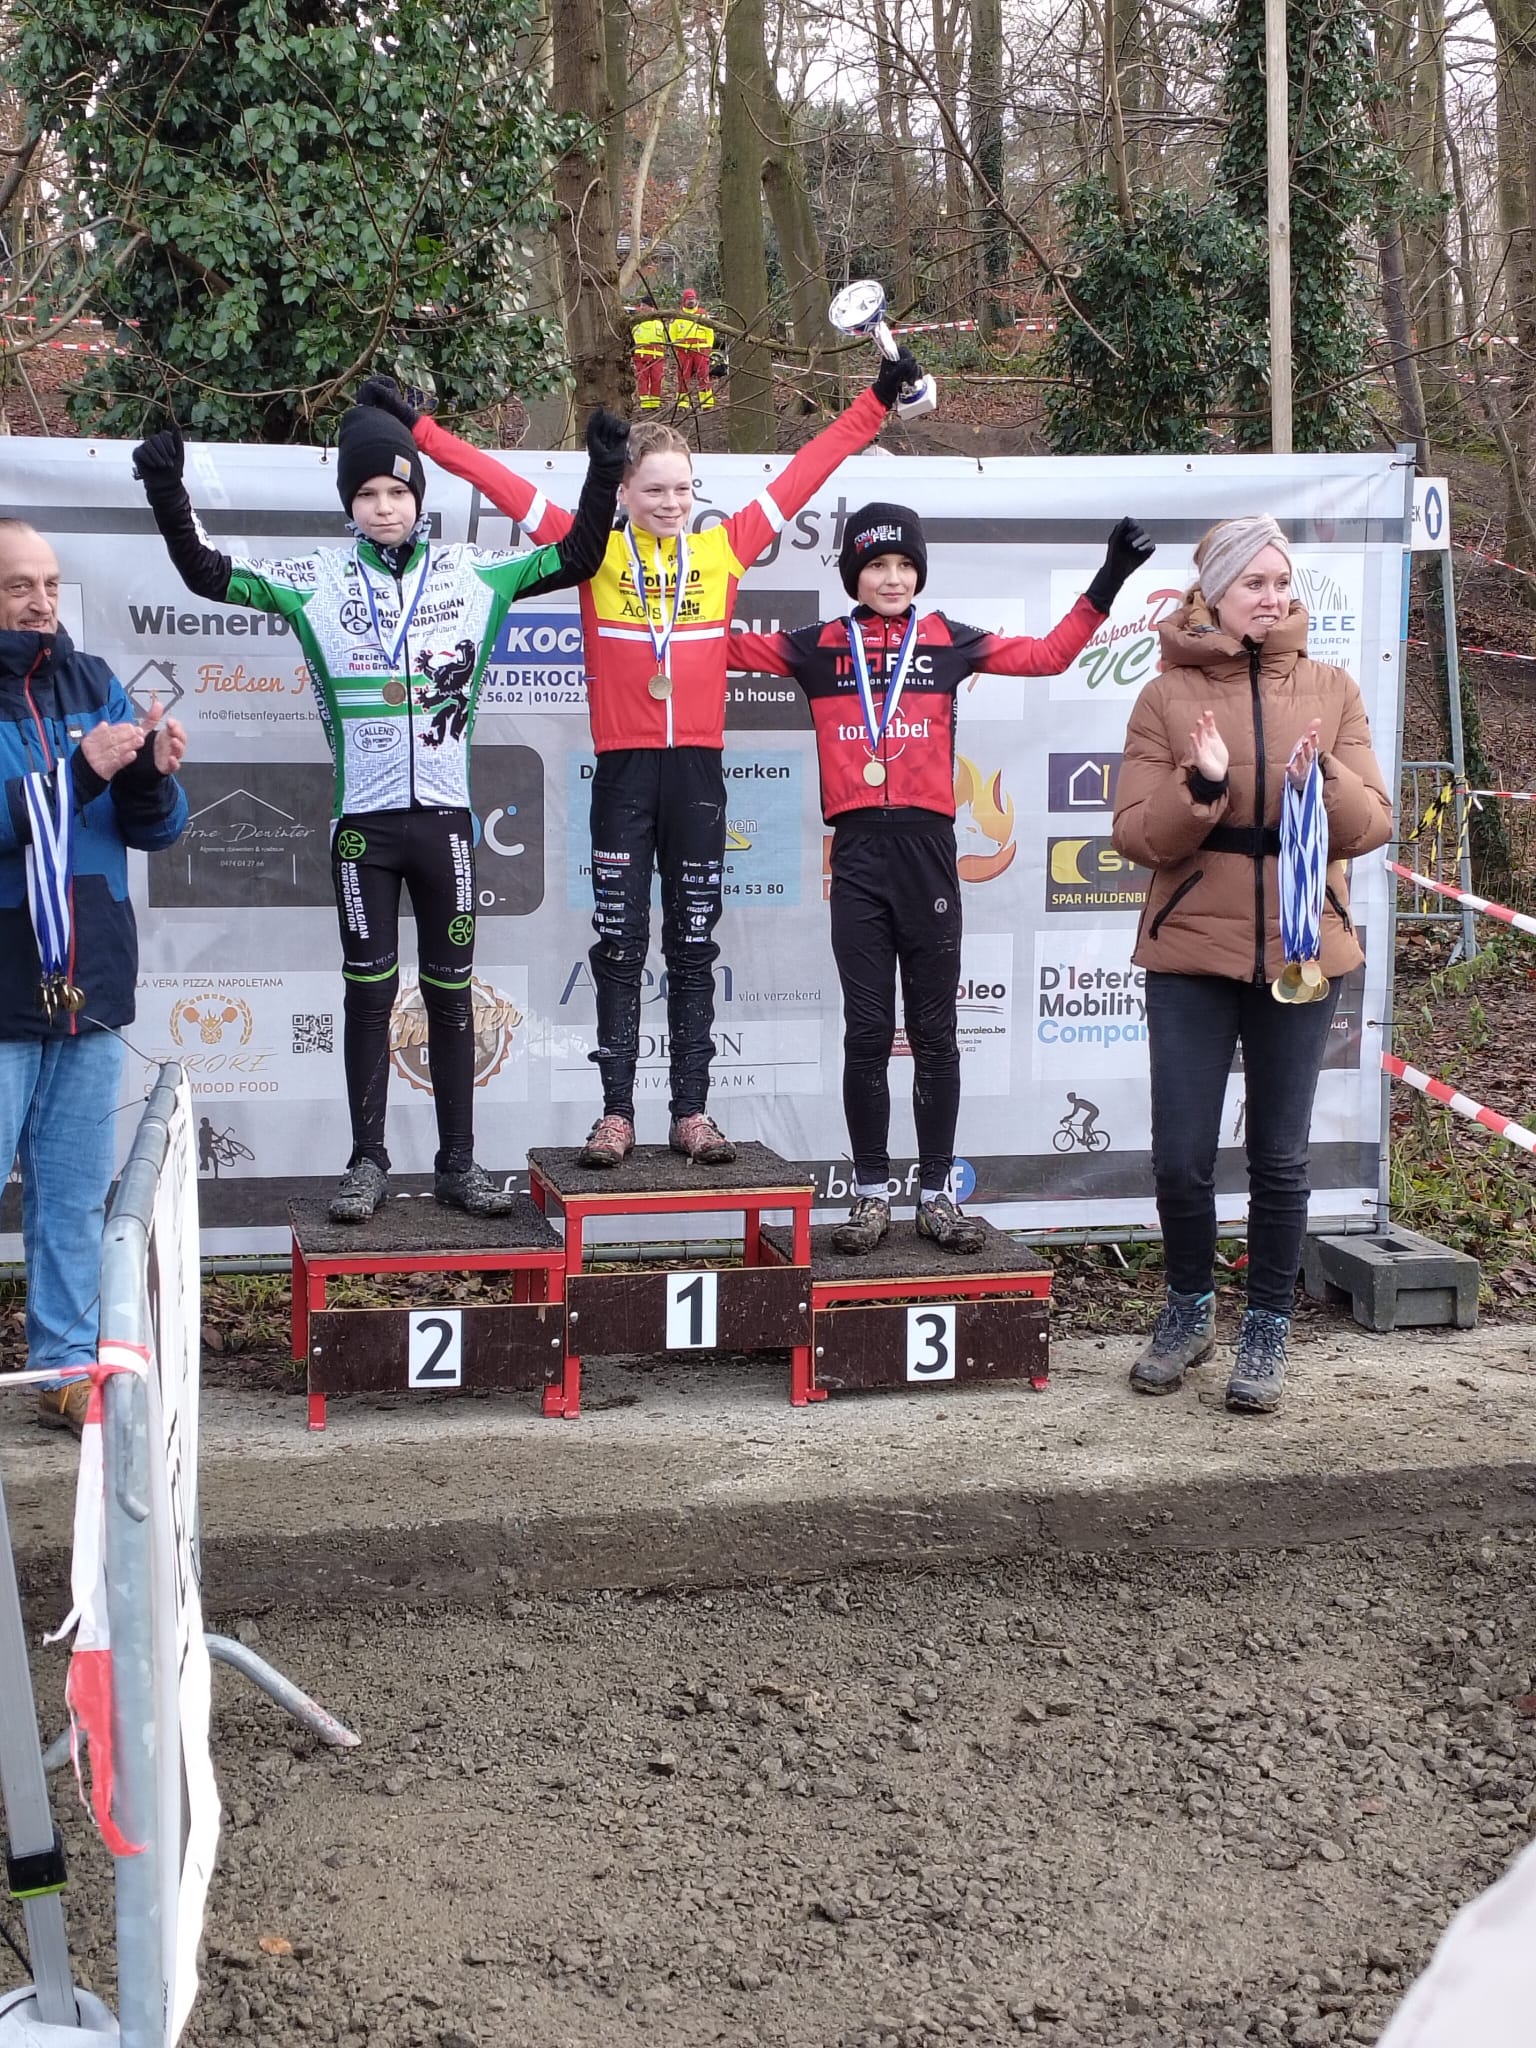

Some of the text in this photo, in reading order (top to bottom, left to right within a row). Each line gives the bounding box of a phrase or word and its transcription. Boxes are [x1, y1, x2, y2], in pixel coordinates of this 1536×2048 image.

[620, 570, 701, 587] LONAD
[420, 597, 465, 616] BELGIAN
[507, 626, 584, 653] KOC
[1309, 637, 1350, 645] EUREN
[195, 663, 286, 695] Fietsen
[748, 688, 796, 702] house
[359, 727, 395, 737] CALLENS
[838, 717, 929, 742] toabel
[449, 832, 464, 877] BELGIAN
[745, 883, 763, 895] 53
[766, 882, 785, 895] 80
[348, 861, 370, 940] ANGLO BELGIAN
[1051, 892, 1147, 905] SPAR HULDENB
[152, 978, 179, 988] VERA
[182, 978, 214, 988] PIZZA
[217, 978, 284, 988] NAPOLETANA
[738, 987, 822, 1001] vlot verzekerd
[1039, 992, 1148, 1021] Mobility
[191, 1081, 279, 1093] MOOD FOOD
[710, 1073, 756, 1088] BANK
[676, 1277, 702, 1346] 1
[415, 1318, 456, 1380] 2
[913, 1313, 948, 1374] 3
